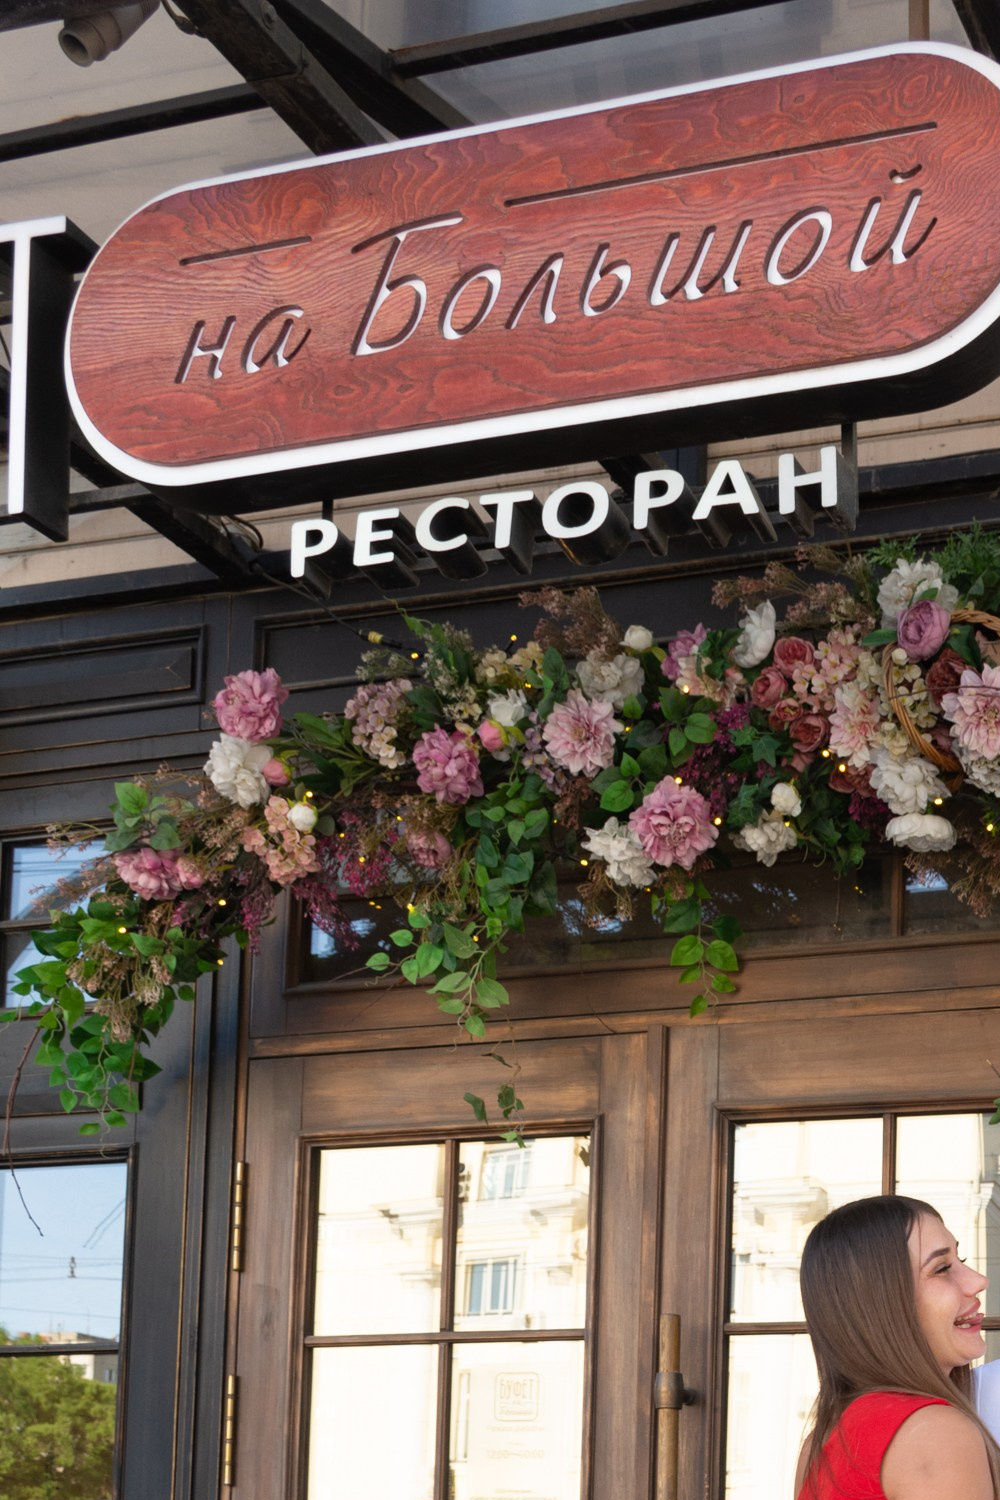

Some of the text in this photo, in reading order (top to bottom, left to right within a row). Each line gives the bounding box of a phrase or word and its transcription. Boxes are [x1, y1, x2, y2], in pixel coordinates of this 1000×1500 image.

[174, 163, 939, 384] на Большой
[290, 445, 838, 578] РЕСТОРАН
[499, 1378, 534, 1400] БУФЕТ
